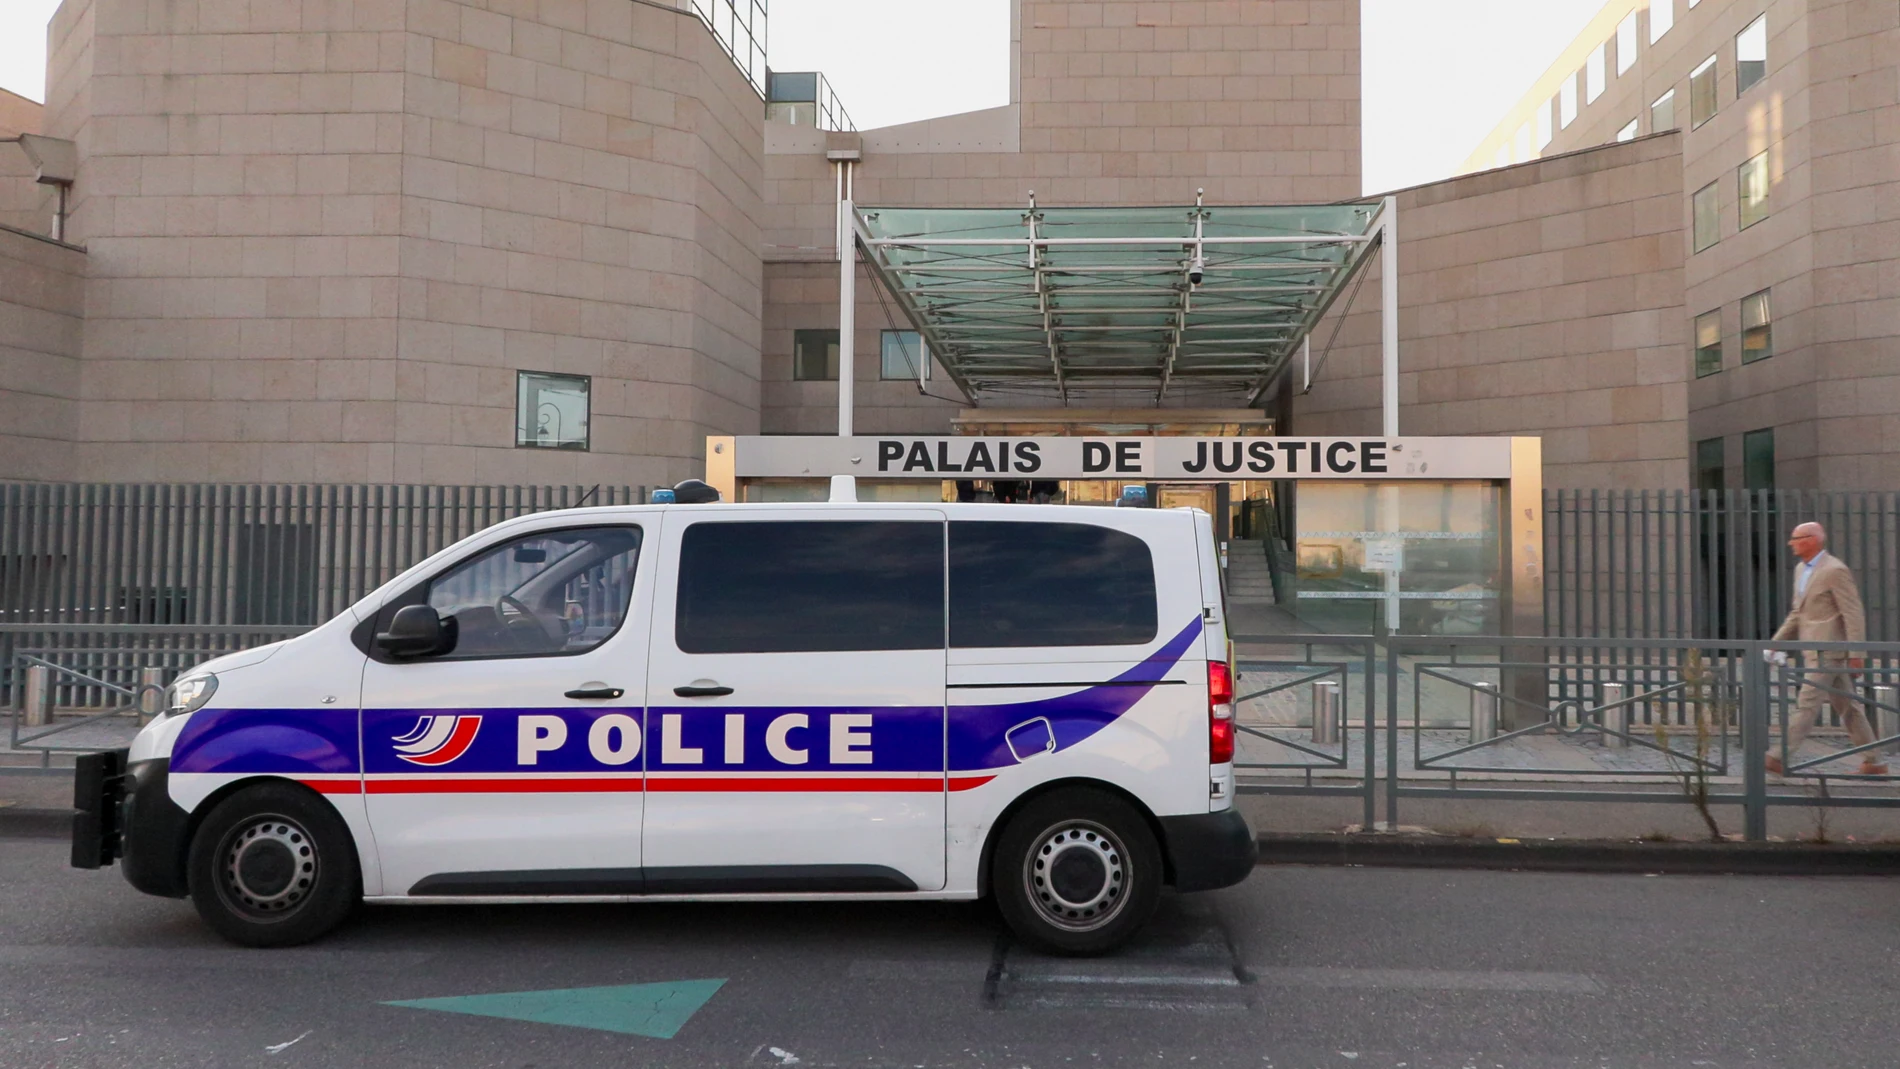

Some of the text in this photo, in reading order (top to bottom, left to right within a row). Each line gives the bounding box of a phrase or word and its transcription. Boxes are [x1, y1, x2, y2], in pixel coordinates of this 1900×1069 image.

[878, 440, 1388, 474] PALAIS DE JUSTICE
[516, 713, 874, 766] POLICE
